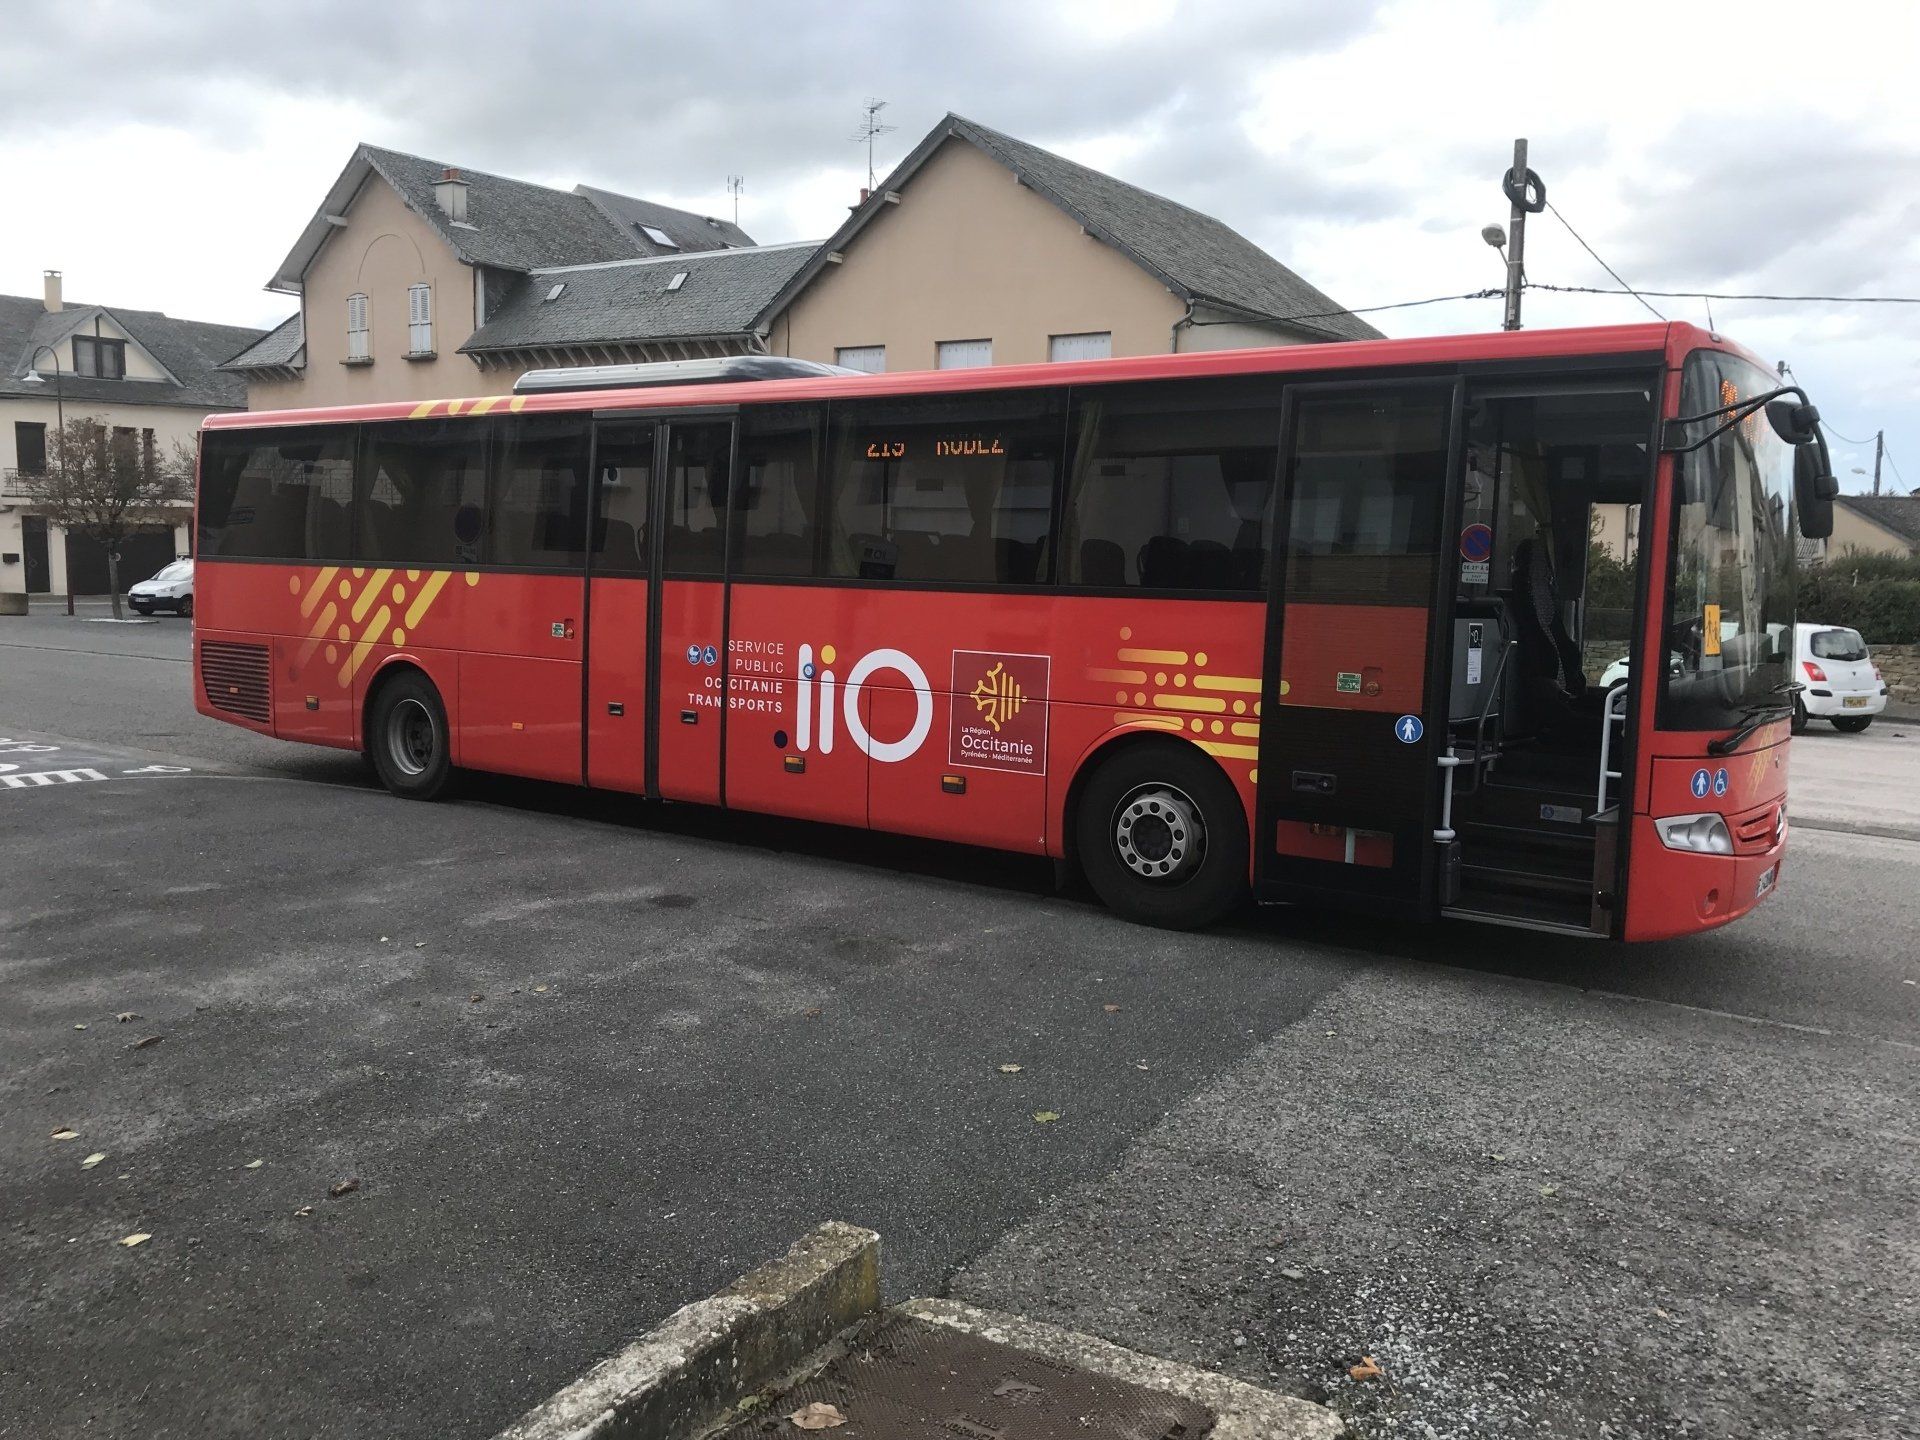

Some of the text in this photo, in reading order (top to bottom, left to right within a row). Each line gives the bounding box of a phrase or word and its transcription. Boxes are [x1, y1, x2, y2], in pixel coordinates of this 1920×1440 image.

[728, 639, 784, 655] SERVICE
[735, 658, 784, 674] PUBLIC
[704, 676, 783, 694] OCCITANIE
[688, 692, 783, 713] TRANSPORTS
[969, 726, 991, 736] Région
[961, 734, 1033, 755] Occitanie
[960, 749, 988, 759] Pyrénées
[992, 753, 1033, 764] Méditerranée
